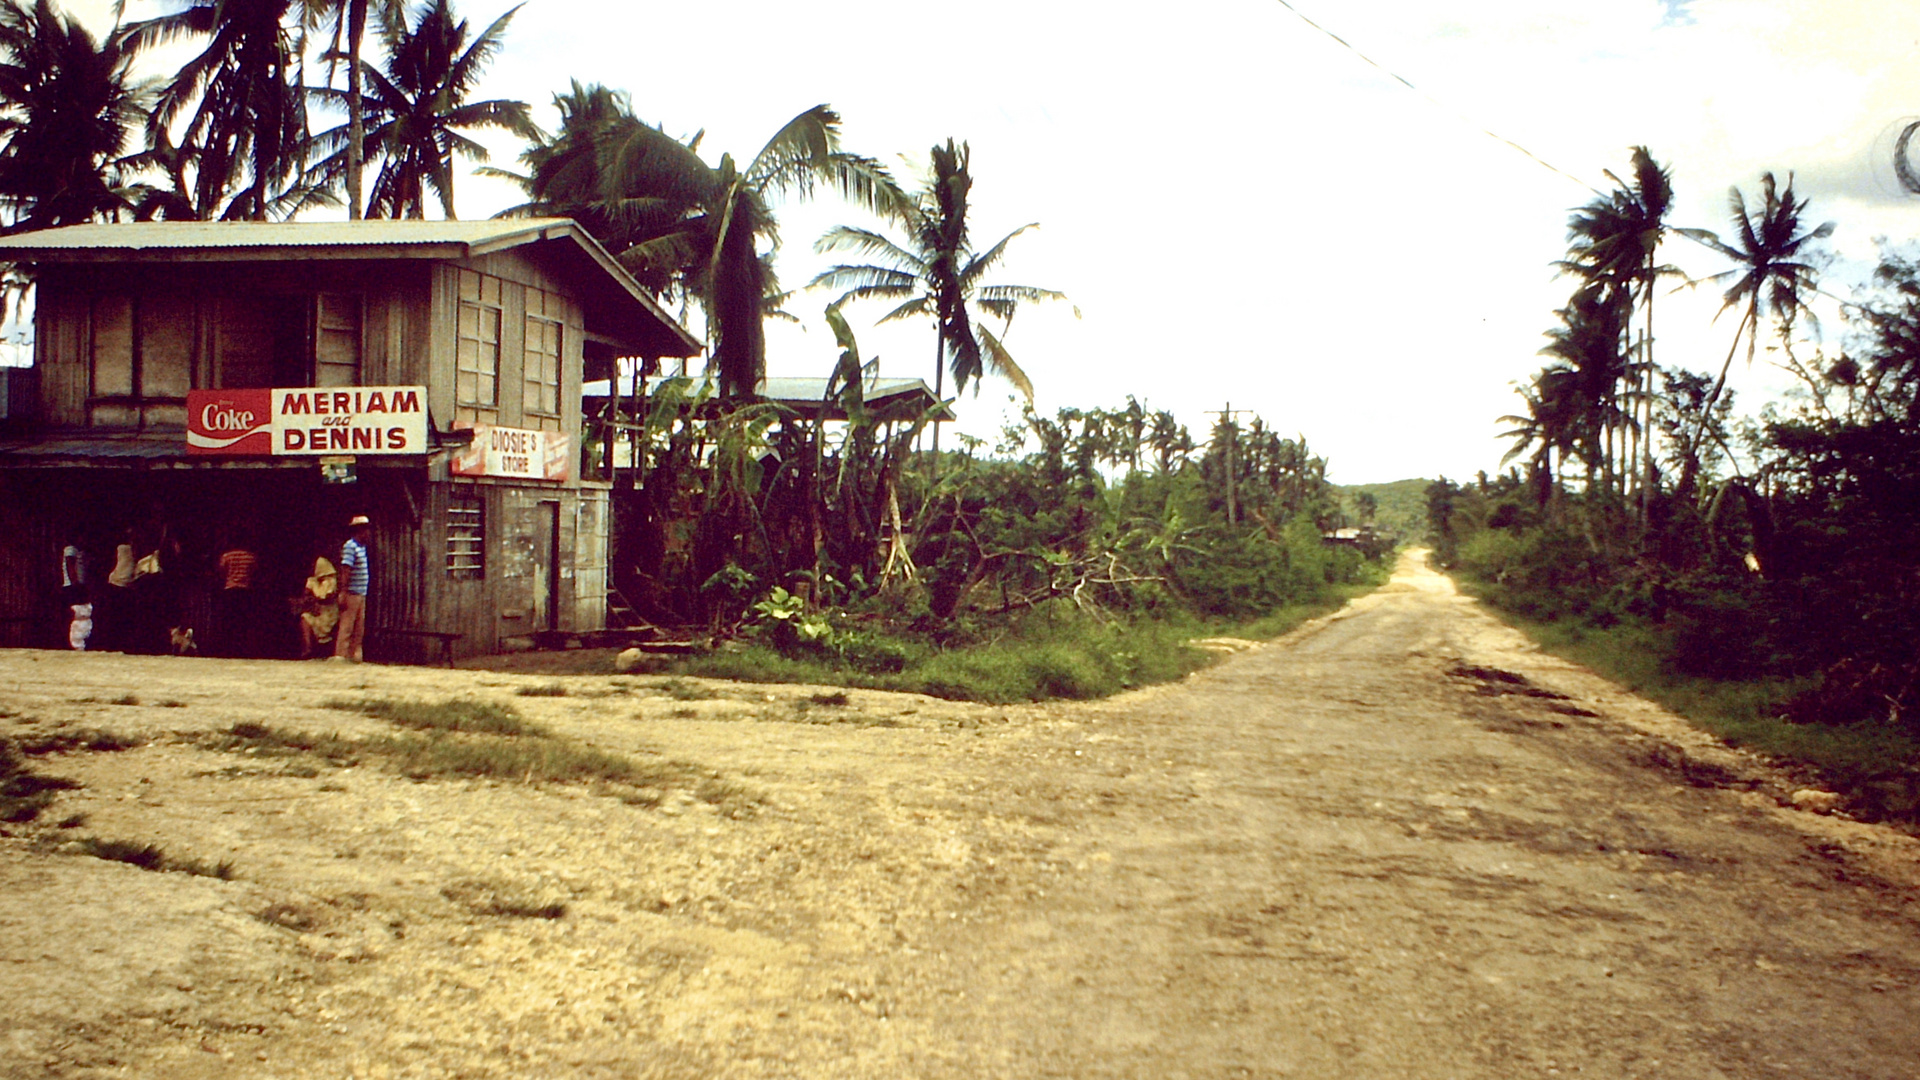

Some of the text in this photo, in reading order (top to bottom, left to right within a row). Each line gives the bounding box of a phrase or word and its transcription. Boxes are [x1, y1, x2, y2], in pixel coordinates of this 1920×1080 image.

[281, 391, 420, 415] MERIAM
[202, 403, 254, 430] Coke
[284, 427, 406, 451] DENNIS
[502, 455, 529, 473] STORE
